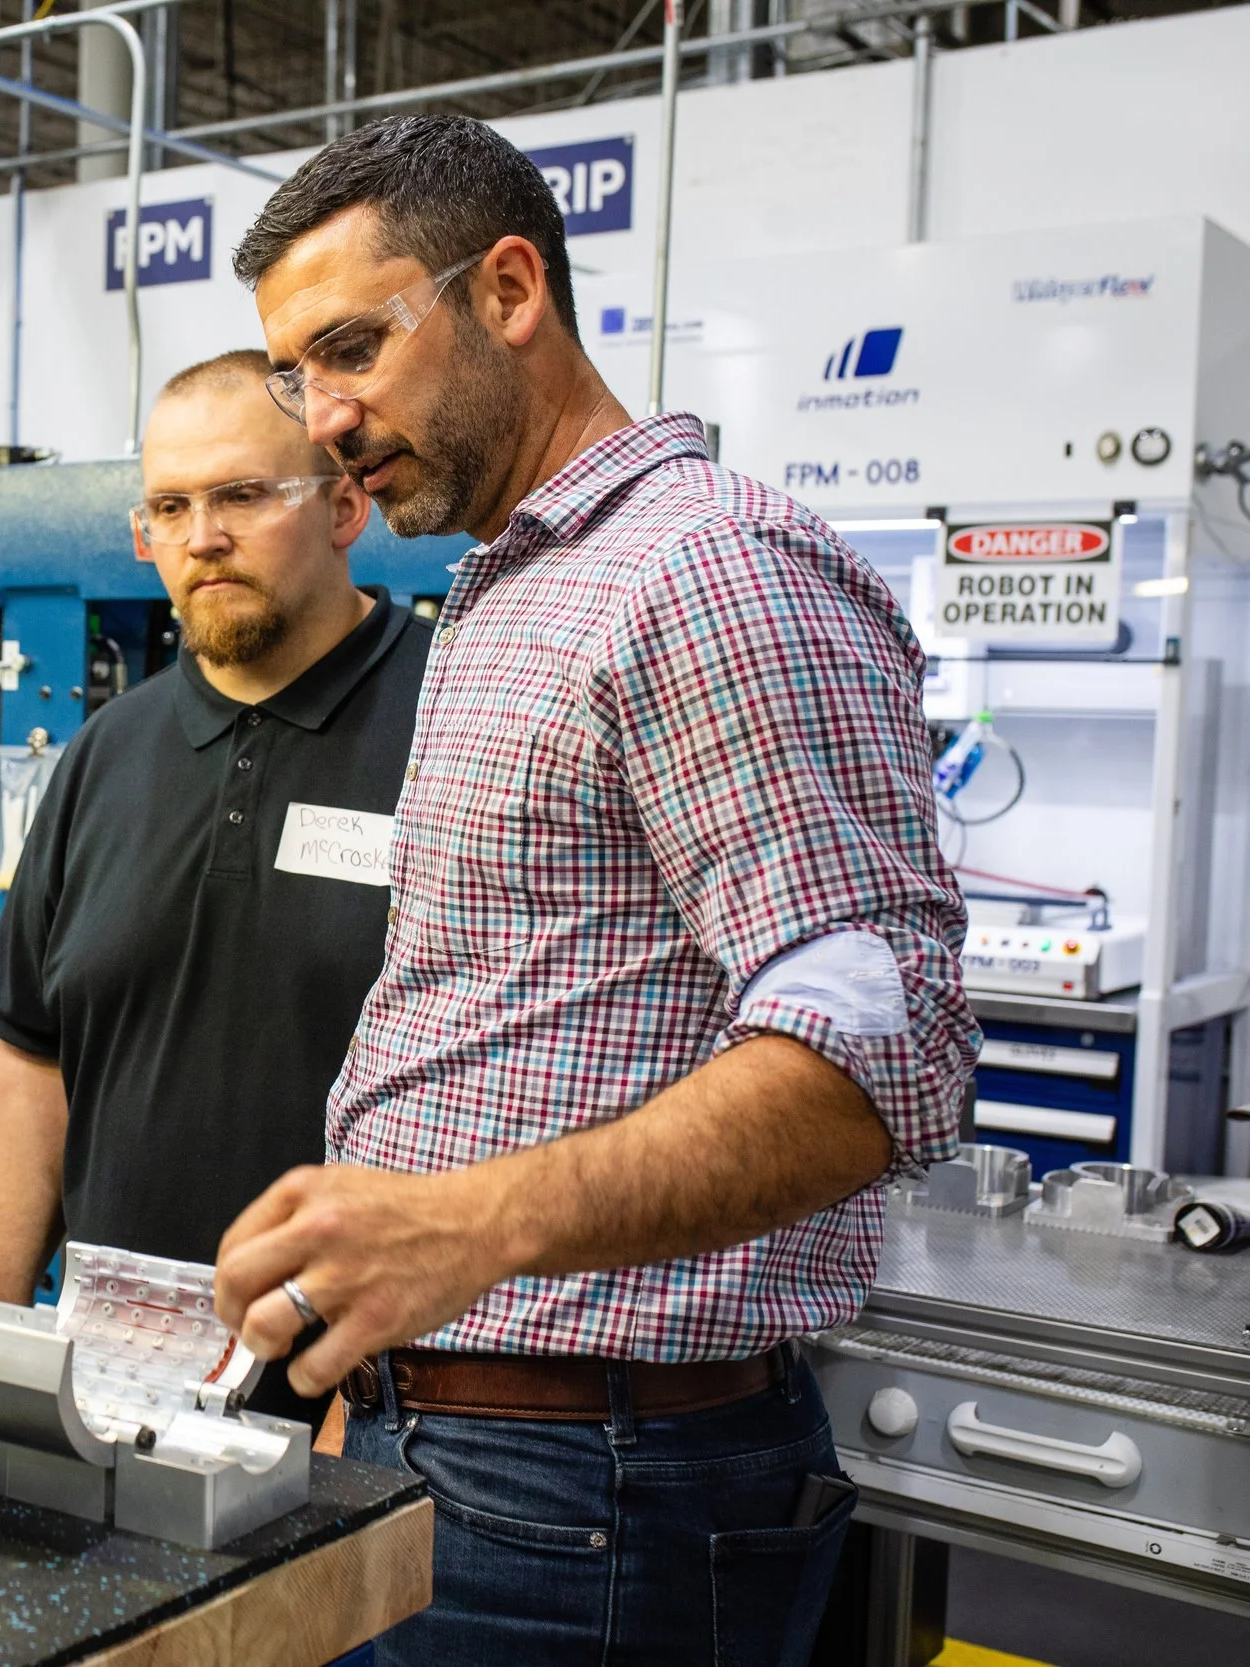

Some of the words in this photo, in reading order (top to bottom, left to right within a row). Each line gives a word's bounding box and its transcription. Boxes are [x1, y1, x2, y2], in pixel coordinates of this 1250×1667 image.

[541, 158, 626, 216] RIP
[785, 461, 839, 487] FPM
[866, 458, 919, 485] 008
[970, 530, 1084, 557] DANGER
[958, 575, 1053, 597] ROBOT
[1065, 574, 1094, 596] IN
[943, 602, 1107, 625] OPERATION
[300, 807, 364, 836] Derek
